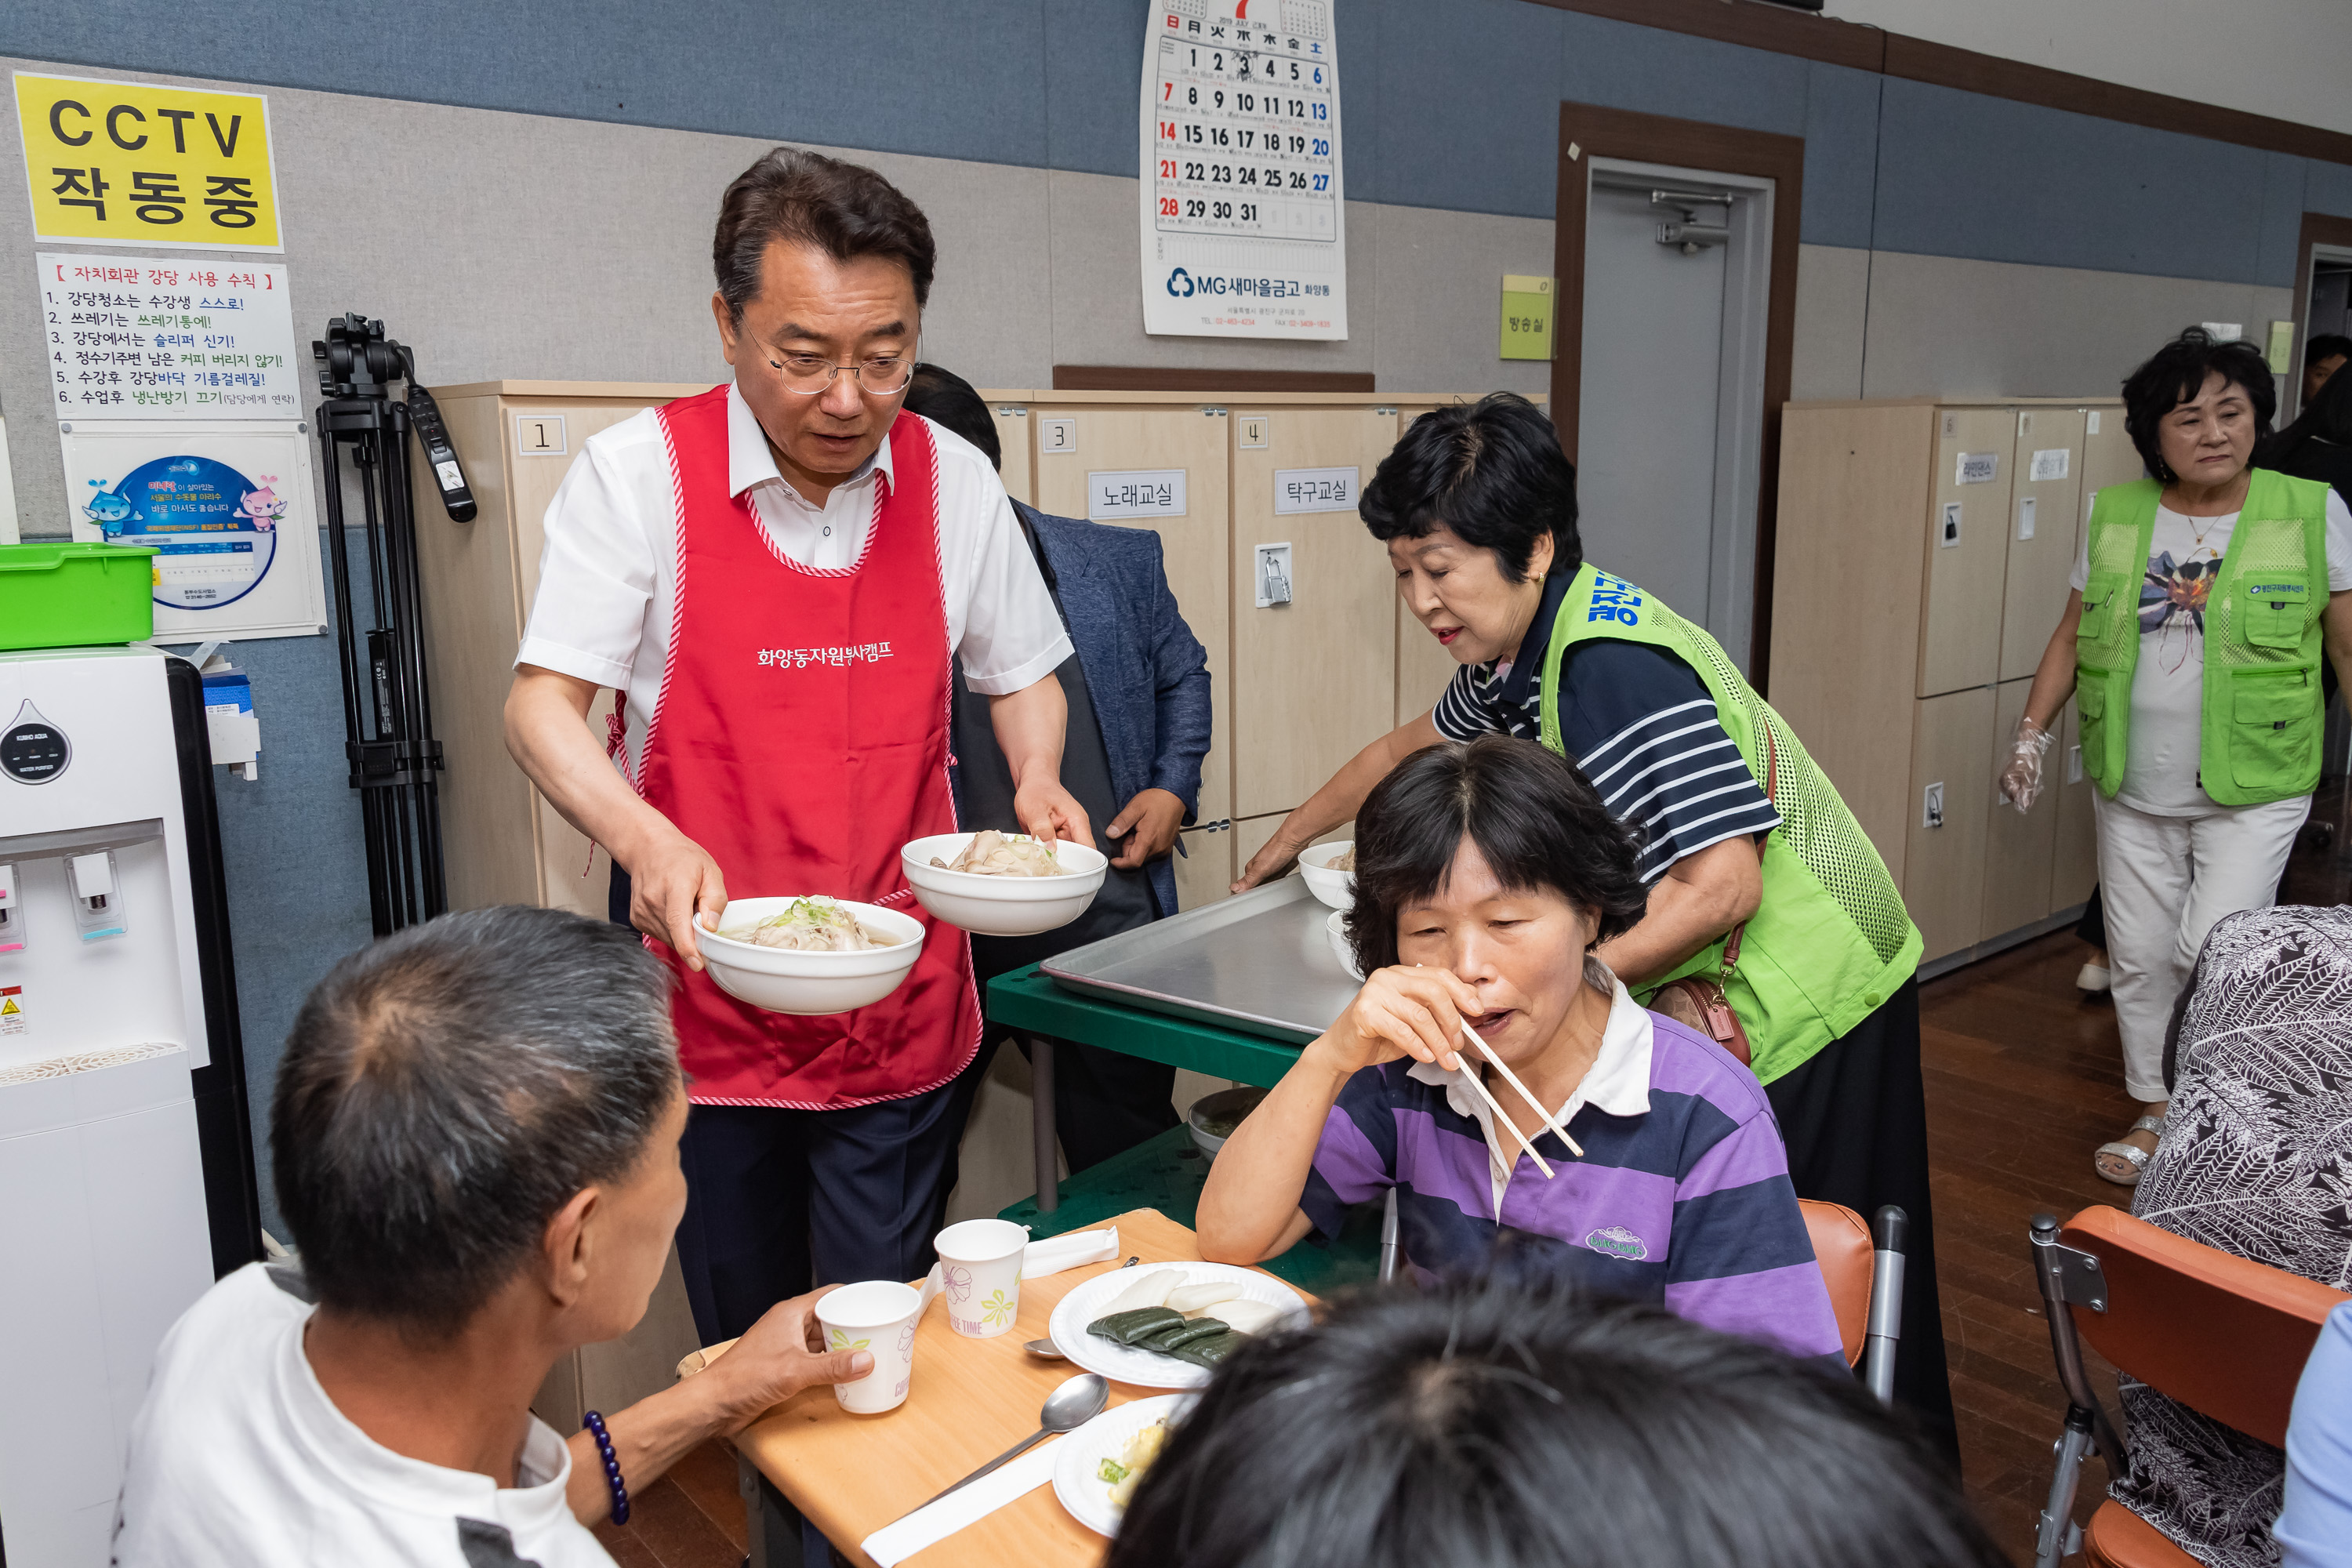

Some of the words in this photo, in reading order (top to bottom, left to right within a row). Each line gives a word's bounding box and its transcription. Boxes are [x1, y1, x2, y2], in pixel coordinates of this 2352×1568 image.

[1167, 15, 1179, 29] 日
[1189, 20, 1200, 34] 月
[1211, 26, 1225, 38] 火
[1237, 30, 1250, 42] 水
[1264, 34, 1276, 45] 木
[1288, 38, 1300, 50] 金
[1310, 42, 1322, 54] 土
[1191, 49, 1196, 67] 1
[1214, 53, 1223, 71] 2
[1240, 56, 1249, 74] 3
[1266, 60, 1275, 78] 4
[1290, 62, 1299, 80] 5
[1313, 67, 1322, 84] 6
[1164, 82, 1173, 101] 7
[1189, 87, 1197, 105] 8
[1214, 90, 1224, 108] 9
[1237, 93, 1254, 111] 10
[1264, 97, 1279, 114] 11
[1288, 100, 1304, 118] 12
[1312, 103, 1327, 120] 13
[49, 100, 241, 158] CCTV
[1160, 122, 1176, 141] 14
[1185, 125, 1203, 143] 15
[1210, 128, 1229, 146] 16
[1237, 130, 1254, 148] 17
[1264, 133, 1279, 151] 18
[1288, 136, 1305, 154] 19
[1312, 138, 1329, 156] 20
[1160, 160, 1176, 179] 21
[1185, 162, 1205, 180] 22
[1211, 165, 1232, 183] 23
[1238, 167, 1257, 185] 24
[1265, 169, 1282, 187] 25
[1290, 172, 1307, 189] 26
[1312, 174, 1329, 191] 27
[51, 167, 259, 229] 작동중
[1160, 198, 1179, 216] 28
[1186, 199, 1206, 217] 29
[1213, 201, 1232, 219] 30
[1240, 204, 1257, 221] 31
[74, 266, 140, 284] 자치회관
[148, 270, 179, 285] 강당
[188, 271, 219, 287] 사용
[227, 273, 256, 289] 수칙
[46, 292, 60, 304] 1.
[68, 292, 141, 308] 강당청소는
[149, 295, 191, 310] 수강생
[199, 297, 244, 310] 스스로!
[49, 311, 62, 325] 2.
[71, 312, 129, 327] 쓰레기는
[137, 314, 212, 329] 쓰레기통에!
[1508, 317, 1544, 333] 방송실
[51, 332, 64, 344] 3.
[73, 332, 146, 347] 강당에서는
[153, 333, 194, 347] 슬리퍼
[204, 335, 235, 348] 신기!
[53, 351, 67, 364] 4.
[75, 351, 142, 366] 정수기주변
[148, 352, 175, 366] 남은
[180, 353, 205, 366] 커피
[212, 354, 249, 367] 버리지
[255, 354, 283, 368] 않기!
[56, 371, 70, 384] 5.
[78, 371, 122, 385] 수강후
[194, 372, 266, 387] 기름걸레질!
[59, 390, 72, 404] 6.
[81, 390, 125, 405] 수업후
[132, 390, 187, 405] 냉난방기
[535, 424, 550, 448] 1
[1054, 426, 1065, 446] 3
[1249, 424, 1258, 442] 4
[148, 481, 177, 492] 미네랄
[1103, 483, 1172, 507] 노래교실
[1287, 479, 1347, 503] 탁구교실
[151, 504, 169, 514] 바로
[171, 504, 198, 513] 마셔도
[199, 504, 229, 513] 좋습니다
[1590, 1236, 1617, 1250] BANG
[1617, 1243, 1643, 1256] BANG
[961, 1319, 982, 1334] TIME
